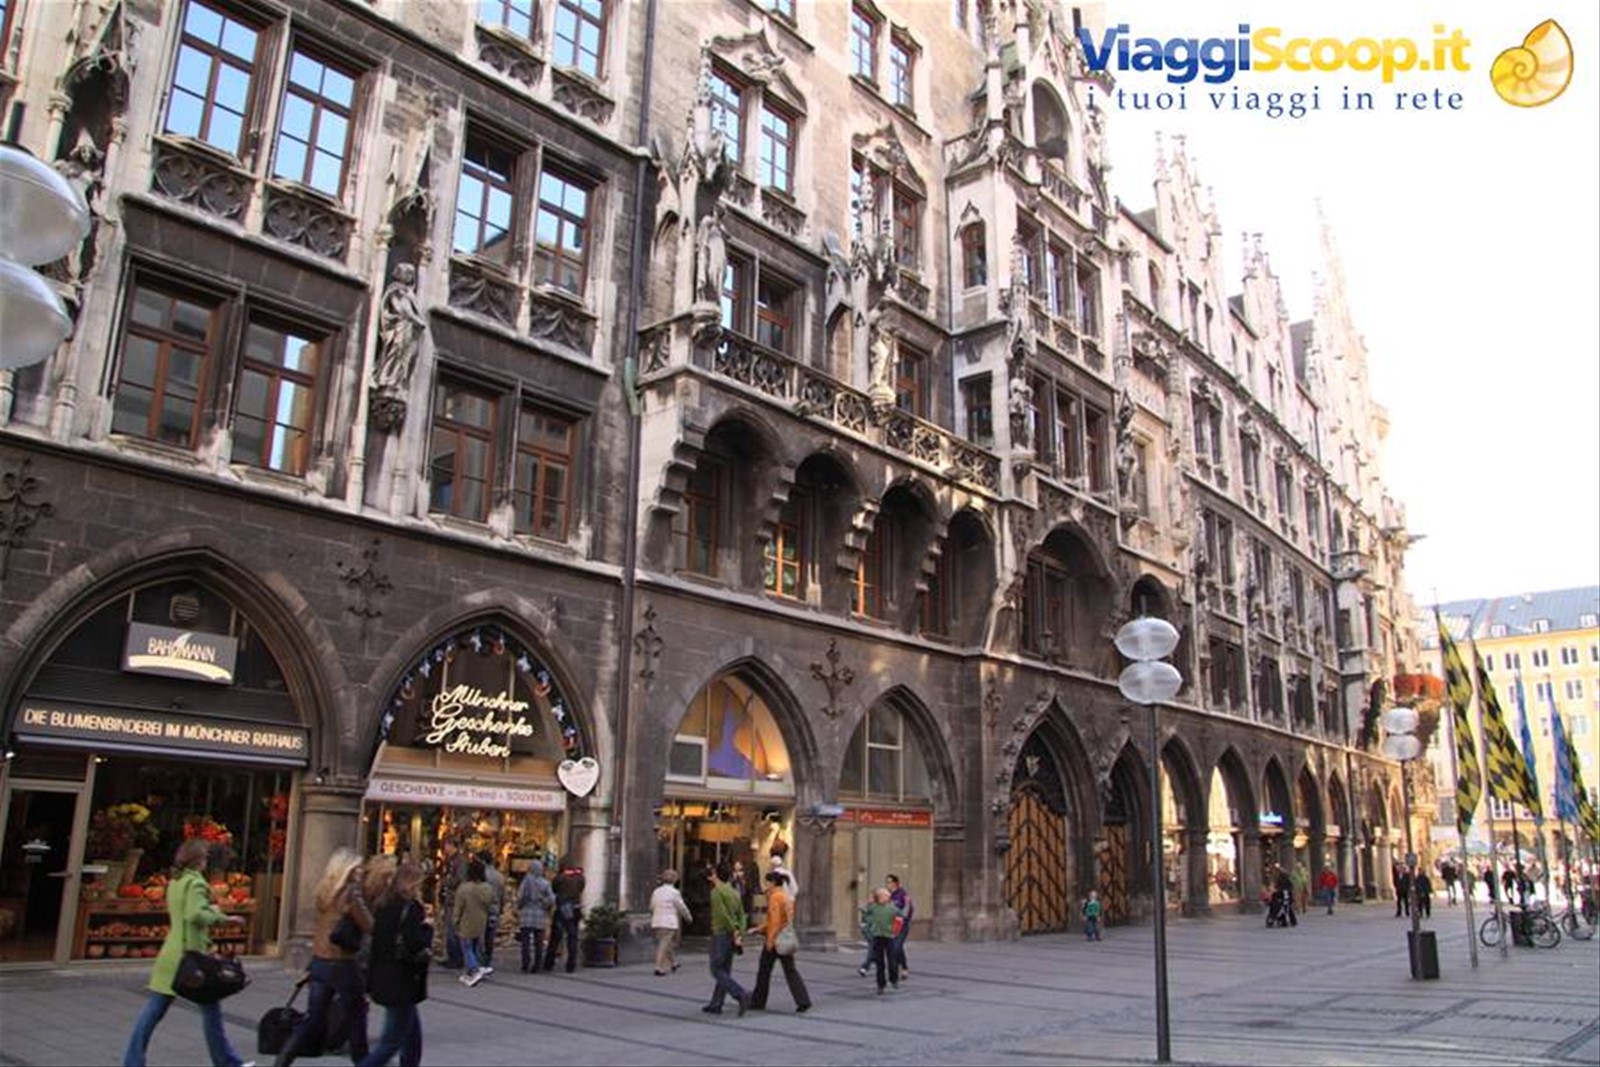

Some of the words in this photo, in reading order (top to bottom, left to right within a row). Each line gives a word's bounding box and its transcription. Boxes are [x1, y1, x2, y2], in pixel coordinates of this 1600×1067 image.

[24, 708, 48, 725] DIE
[50, 710, 162, 736] BLUMENBINDEREI
[165, 722, 181, 737] IM
[183, 722, 251, 745] MÜNCHNER
[252, 731, 303, 750] RATHAUS
[425, 695, 534, 744] Geschenke
[445, 731, 511, 758] Stuben
[380, 782, 445, 797] GESCHENKE
